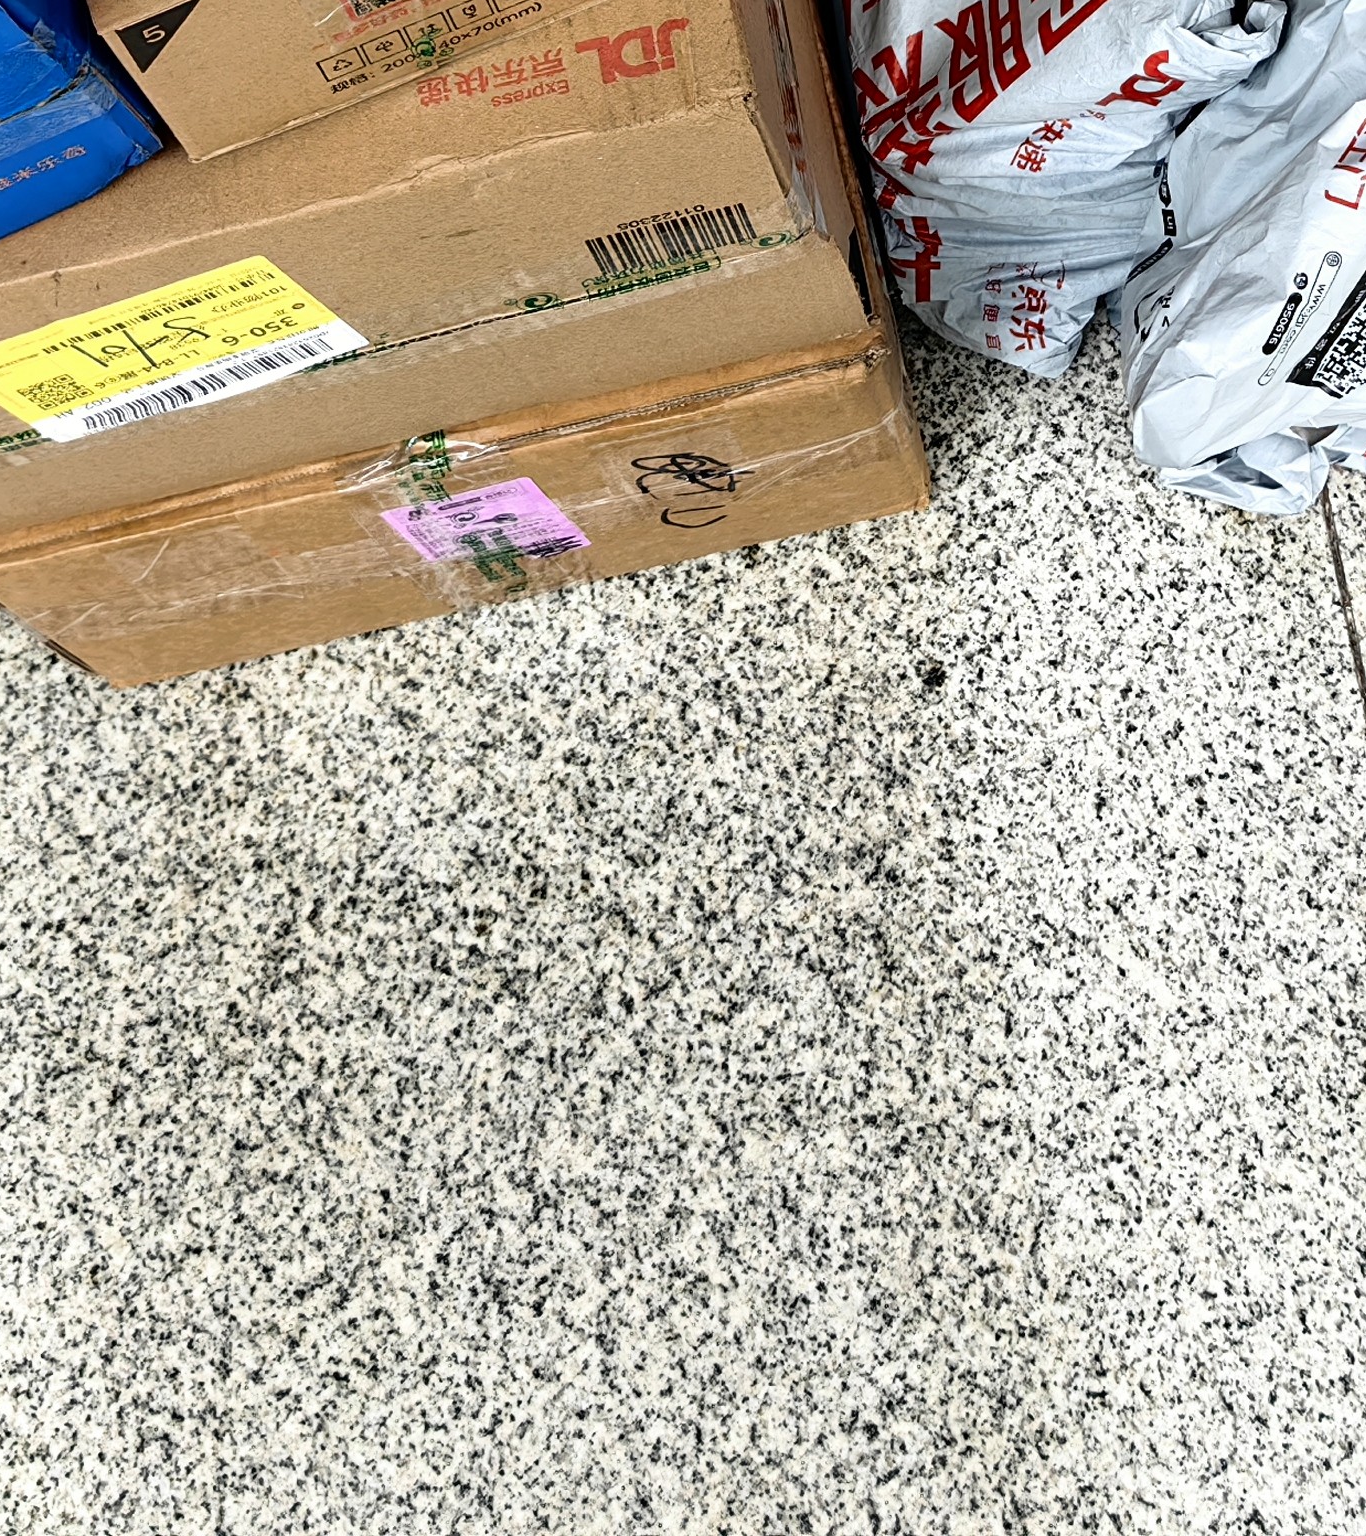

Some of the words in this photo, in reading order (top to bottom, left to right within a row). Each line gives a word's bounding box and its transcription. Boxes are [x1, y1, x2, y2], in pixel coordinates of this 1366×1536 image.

[143, 22, 168, 46] 5
[573, 16, 691, 86] JDL
[415, 44, 567, 108] 京东快递
[489, 77, 572, 109] Express
[617, 202, 706, 232] 01122305
[218, 313, 298, 348] 350-6
[1006, 283, 1050, 354] 京东
[1268, 300, 1295, 347] 950616
